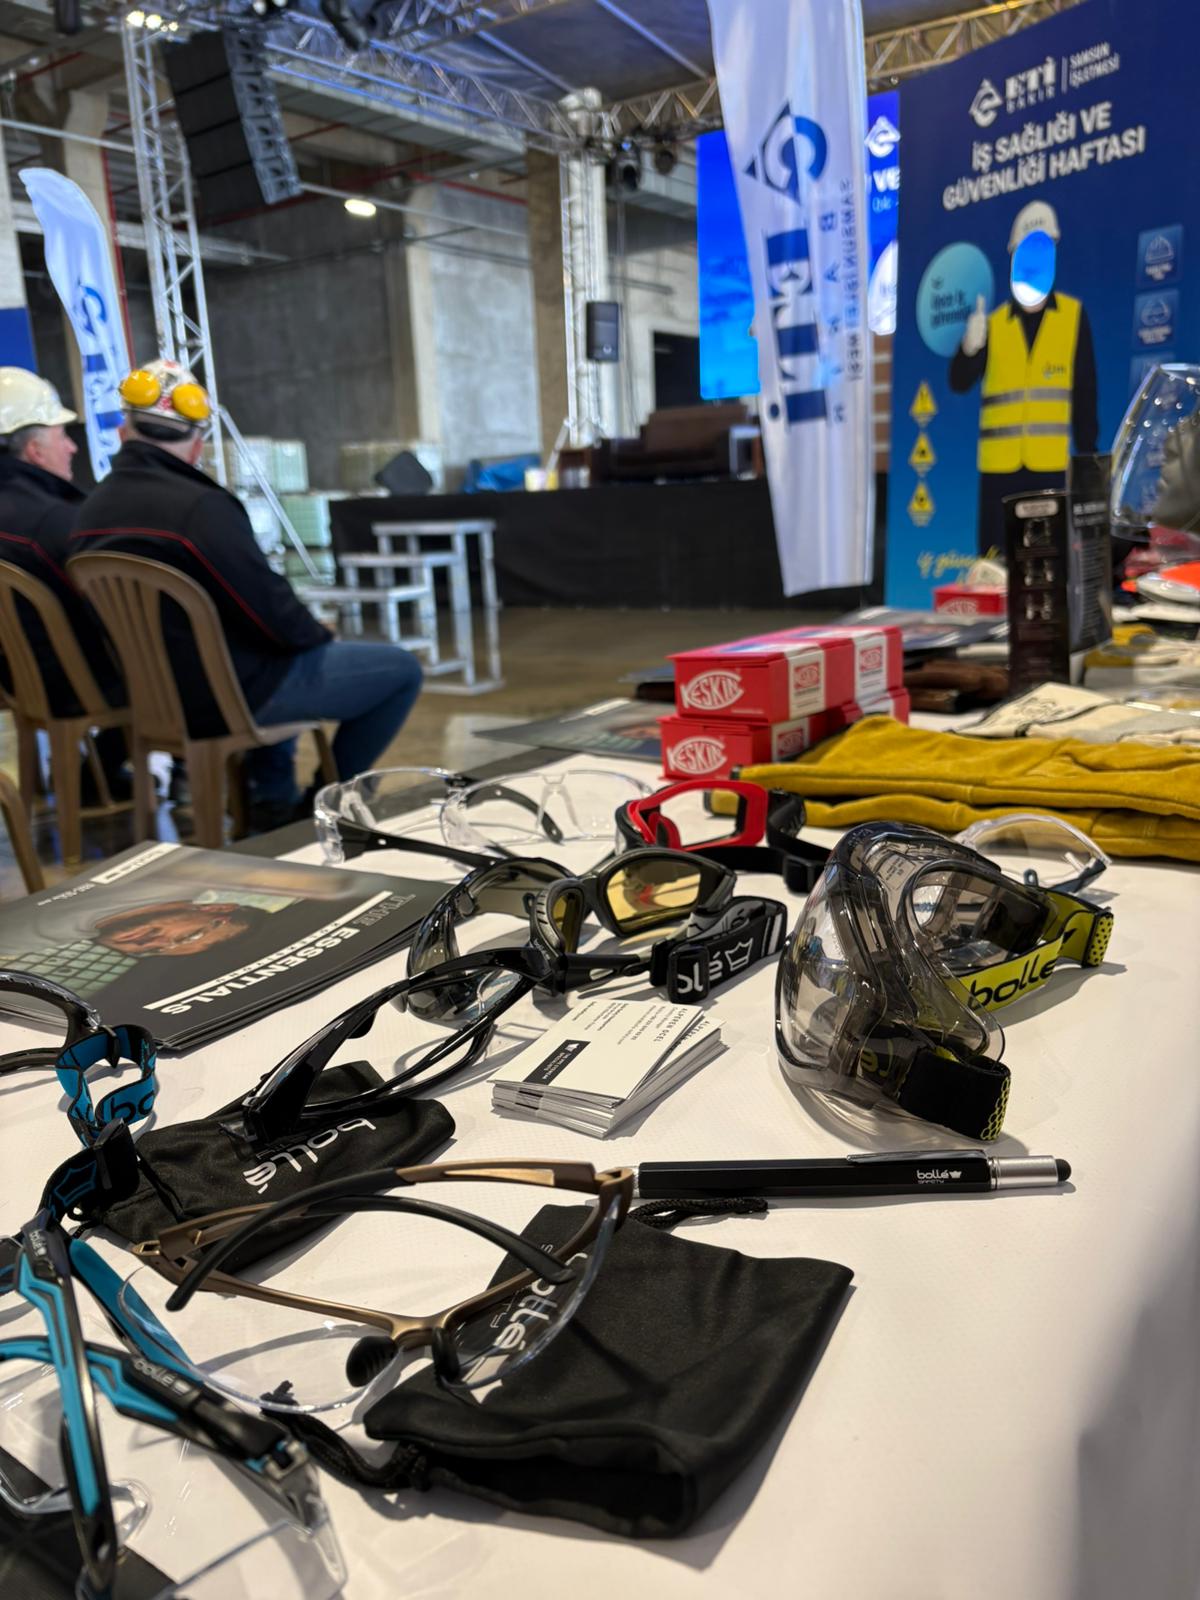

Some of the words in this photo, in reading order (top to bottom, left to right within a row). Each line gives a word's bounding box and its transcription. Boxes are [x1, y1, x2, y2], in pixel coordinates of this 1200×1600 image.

[942, 152, 1046, 211] GÜVENLİĞİ
[1049, 125, 1146, 179] HAFTASI
[972, 141, 993, 173] İŞ
[994, 110, 1077, 163] SAĞLIĞI
[1080, 101, 1112, 134] VE
[159, 926, 361, 1015] ESSENTIALS
[243, 1117, 376, 1194] bollé
[916, 1169, 949, 1180] bollé
